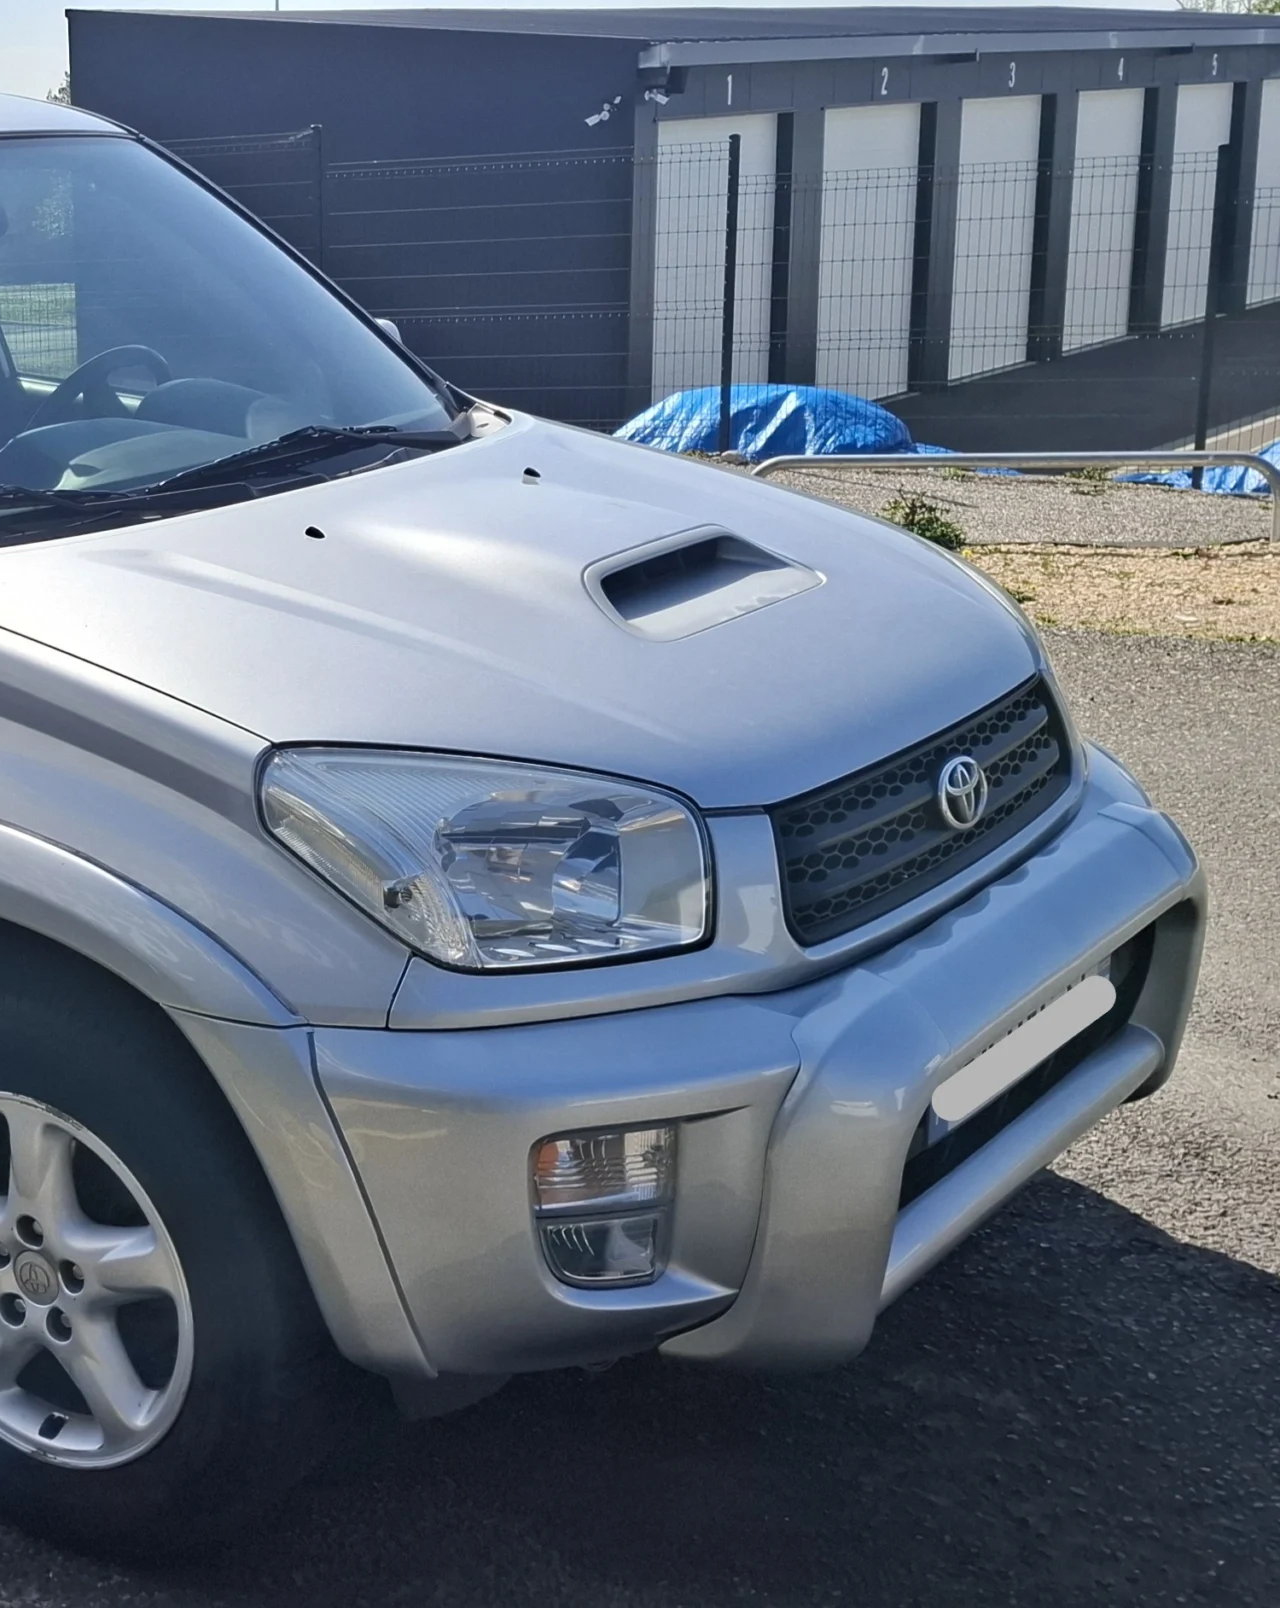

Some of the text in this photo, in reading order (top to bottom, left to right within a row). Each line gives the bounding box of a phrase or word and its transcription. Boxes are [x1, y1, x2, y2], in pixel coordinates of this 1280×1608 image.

[1008, 62, 1016, 87] 3
[1118, 57, 1124, 81] 4
[1212, 53, 1218, 76] 5
[727, 74, 733, 105] 1
[881, 67, 889, 95] 2
